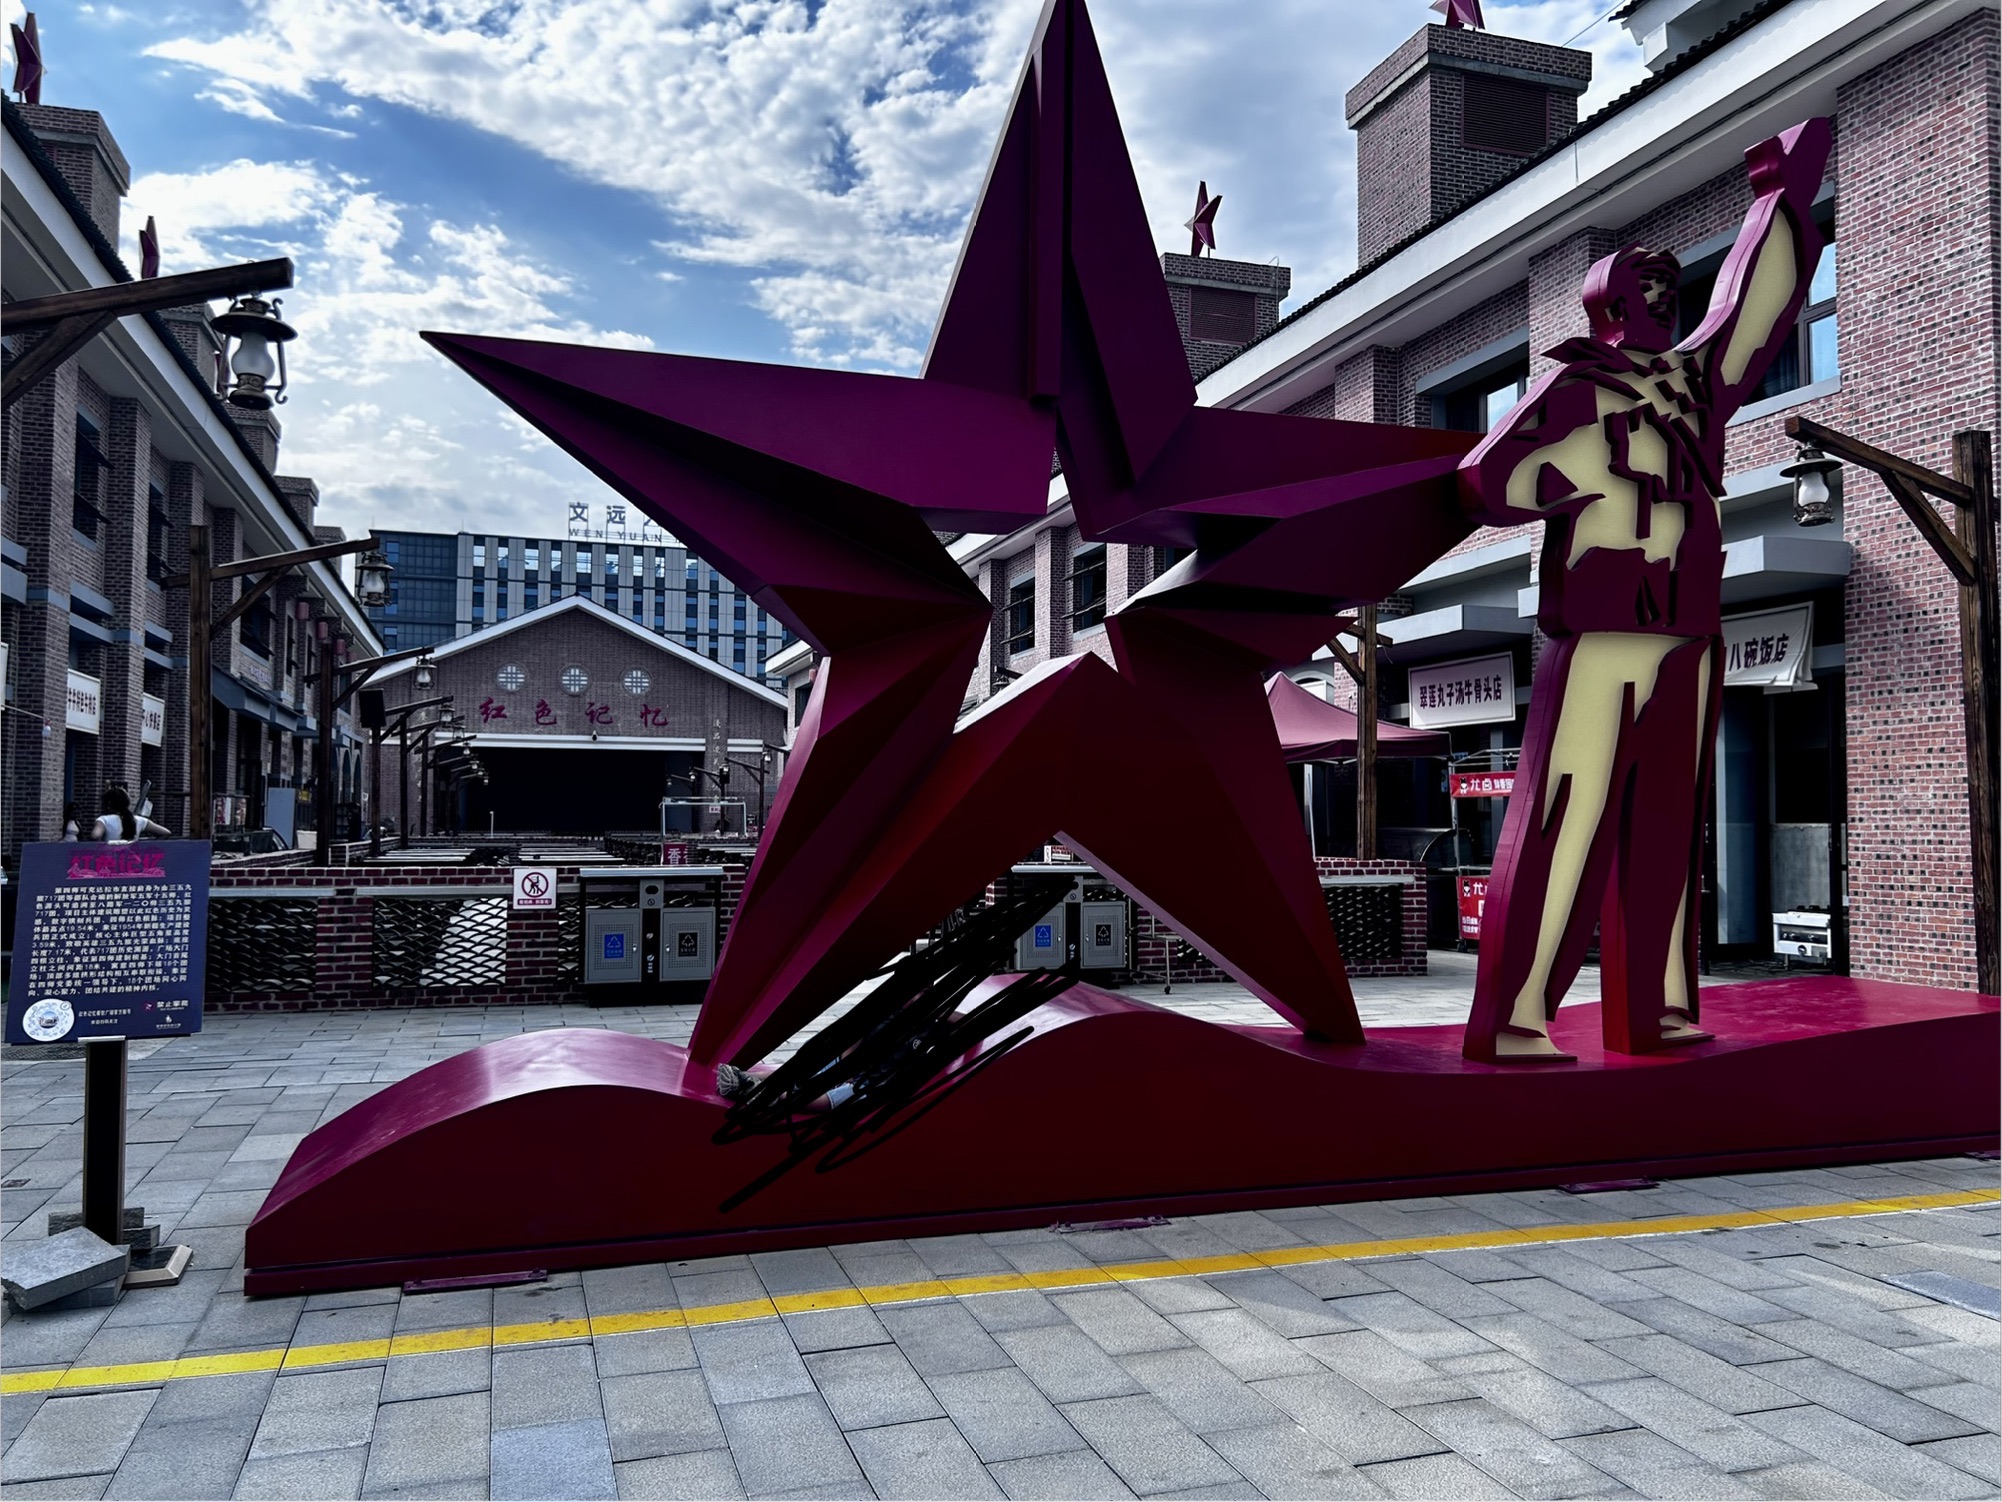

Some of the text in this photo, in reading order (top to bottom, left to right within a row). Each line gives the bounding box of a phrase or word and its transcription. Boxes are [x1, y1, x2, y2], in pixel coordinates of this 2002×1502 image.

[569, 528, 603, 539] WEN
[617, 531, 662, 543] YUAN
[1728, 633, 1789, 672] 八碗饭店
[1419, 674, 1502, 709] 翠莲丸子汤牛骨头店
[479, 697, 669, 728] 红色记忆
